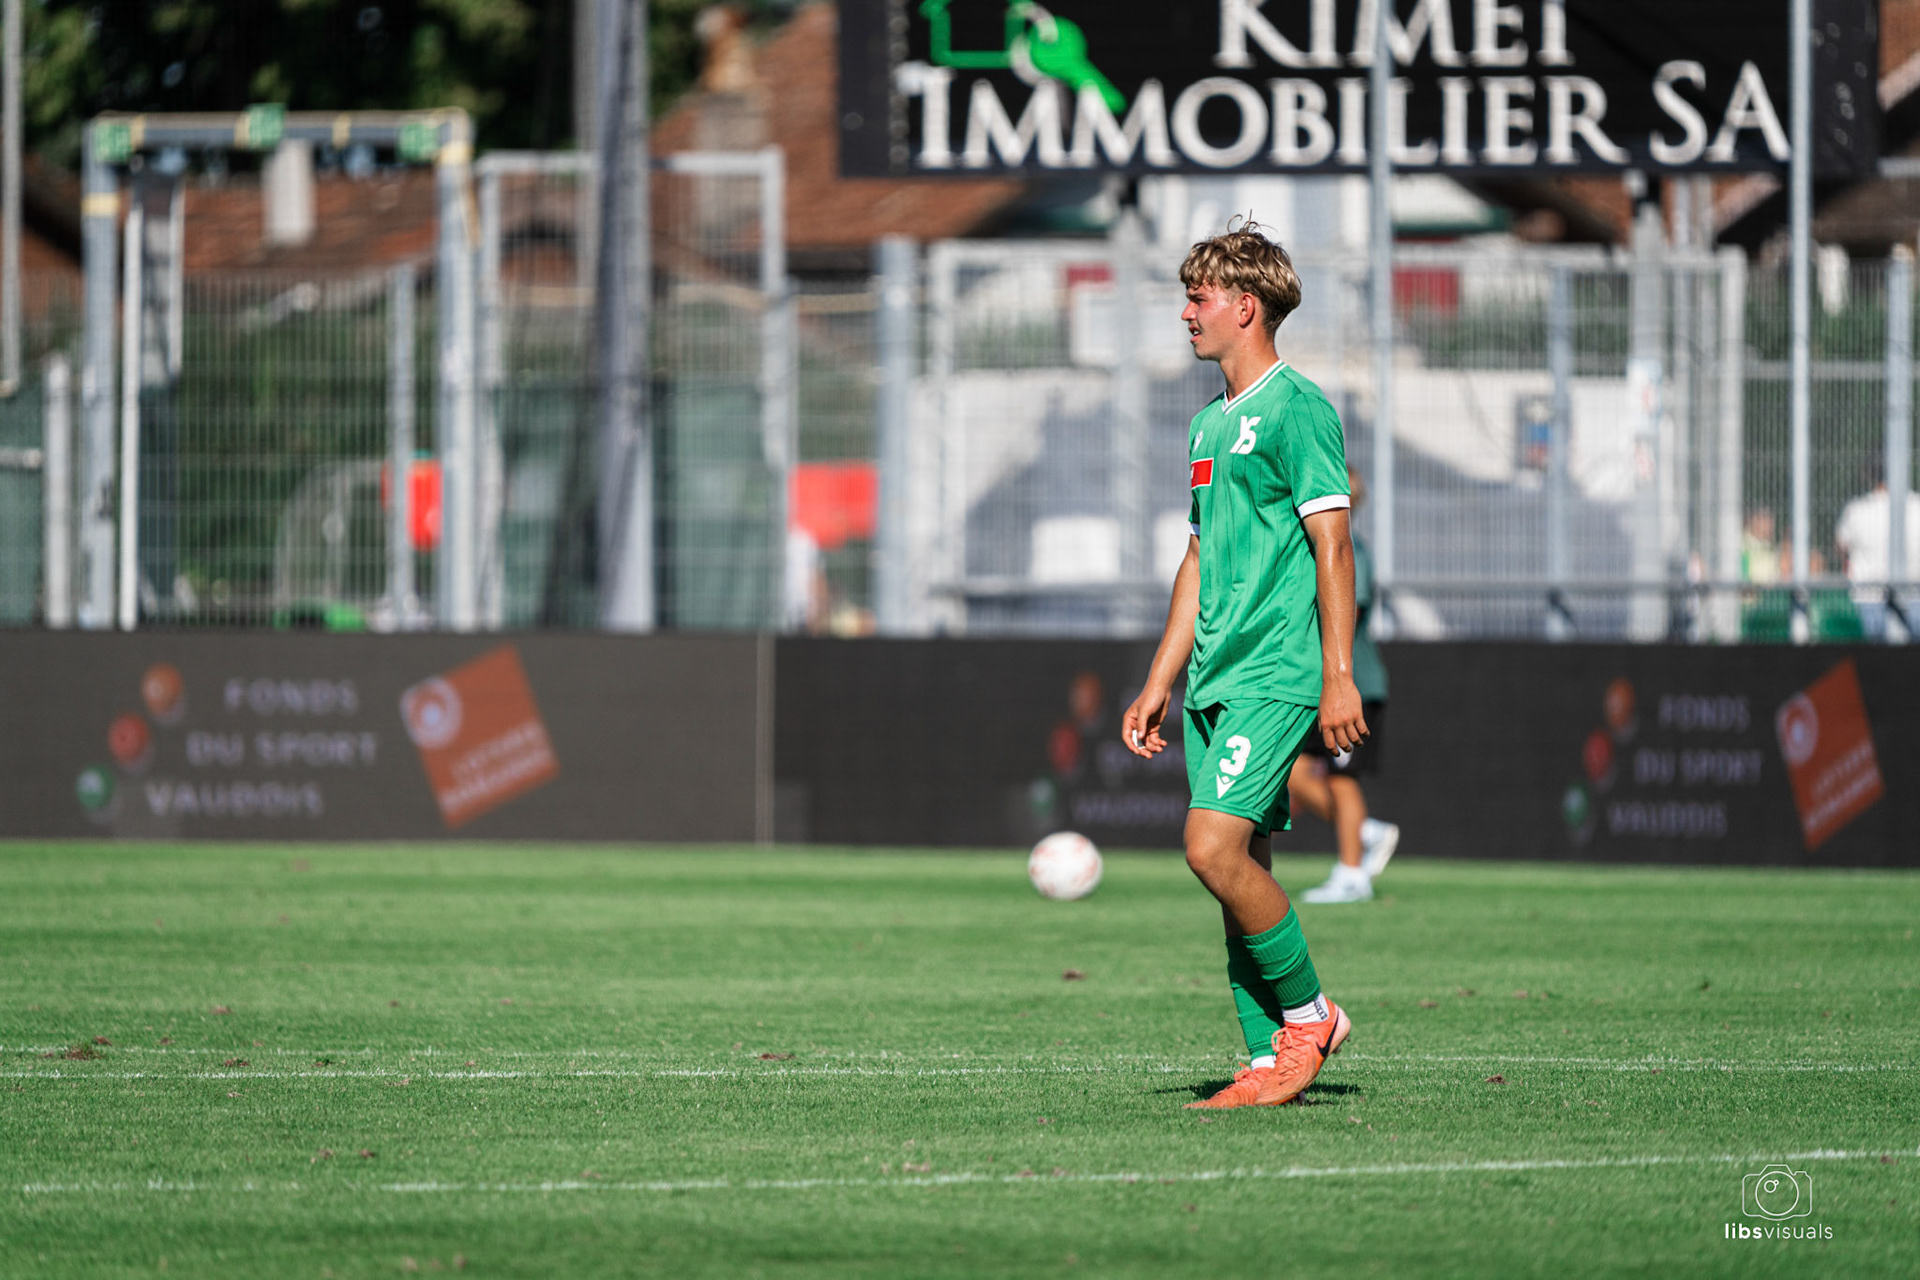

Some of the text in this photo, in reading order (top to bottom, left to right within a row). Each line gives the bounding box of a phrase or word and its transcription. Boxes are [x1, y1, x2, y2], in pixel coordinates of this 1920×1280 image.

[914, 58, 1792, 168] IMMOBILIER SA
[226, 681, 356, 714] FONDS
[1219, 734, 1251, 777] 3
